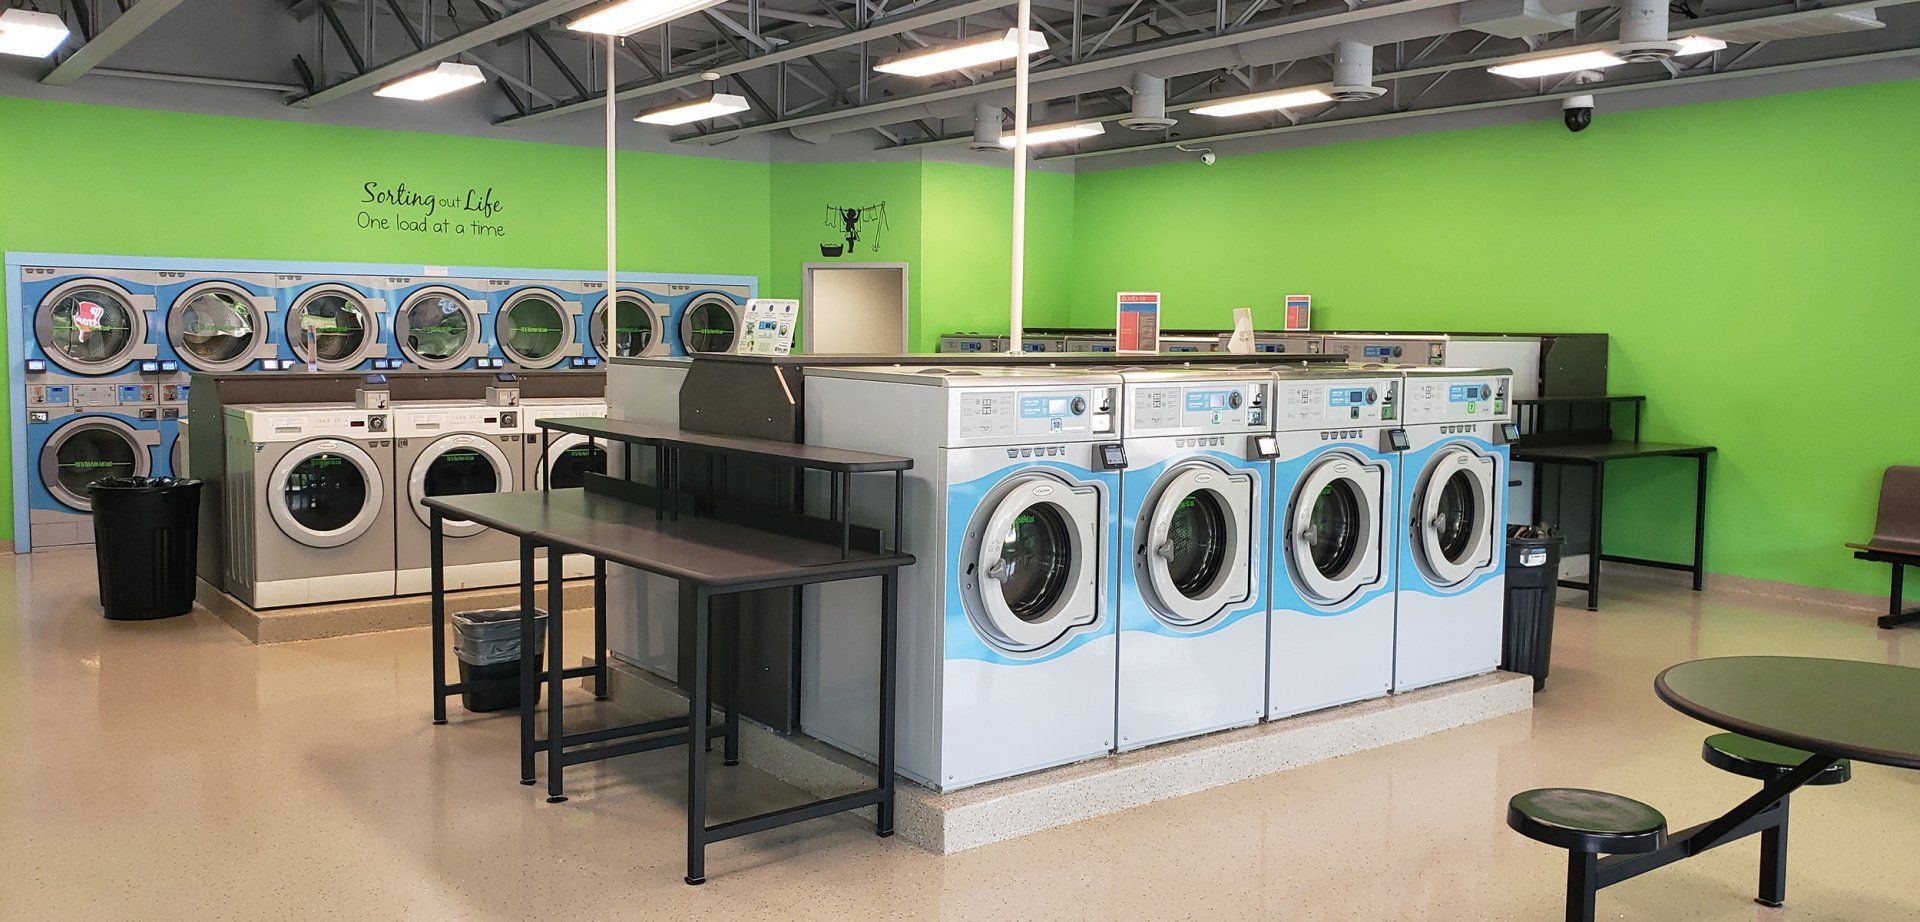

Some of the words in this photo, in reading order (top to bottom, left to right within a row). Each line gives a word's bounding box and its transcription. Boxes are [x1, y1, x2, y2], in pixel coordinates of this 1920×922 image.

[361, 181, 435, 217] Sorting
[439, 196, 461, 208] out
[464, 187, 504, 218] Life
[357, 211, 390, 230] One
[396, 214, 427, 232] load
[433, 218, 450, 234] at
[455, 224, 465, 234] a
[470, 220, 506, 237] time
